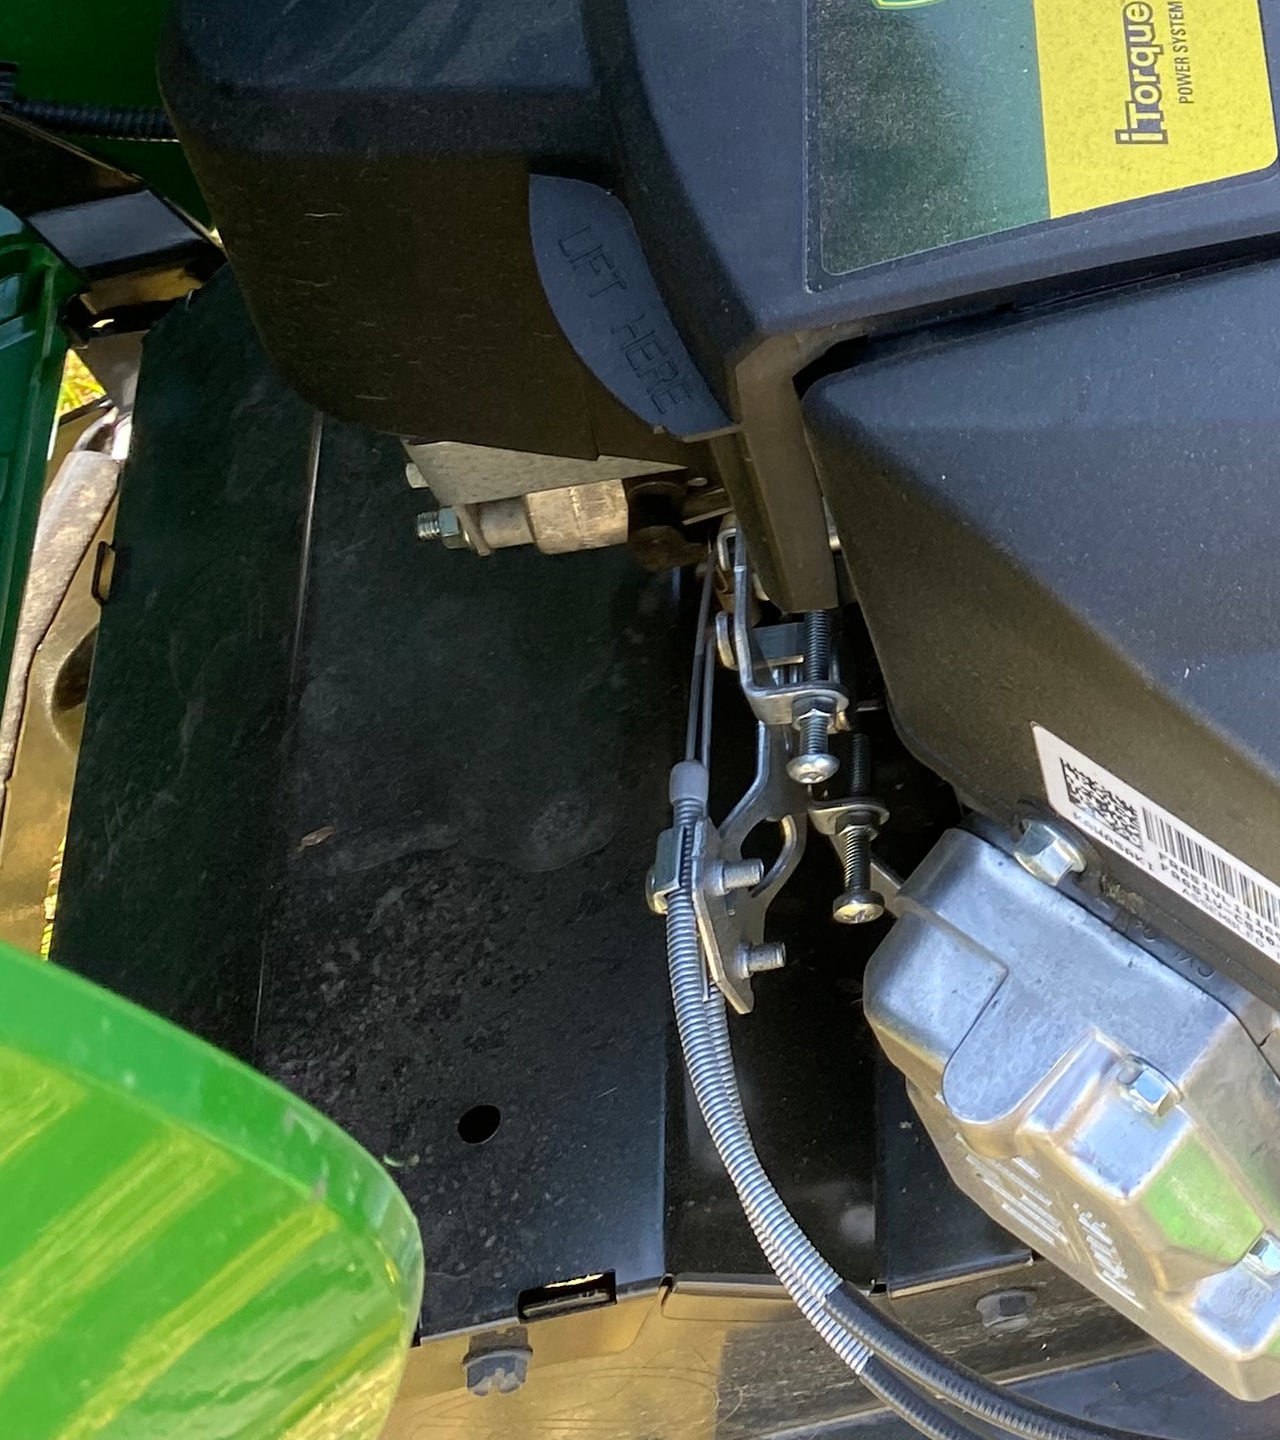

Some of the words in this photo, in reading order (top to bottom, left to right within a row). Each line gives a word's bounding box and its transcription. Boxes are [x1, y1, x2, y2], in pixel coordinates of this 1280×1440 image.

[1171, 55, 1196, 105] POWER
[557, 224, 627, 301] LIFT
[611, 312, 694, 415] HERE
